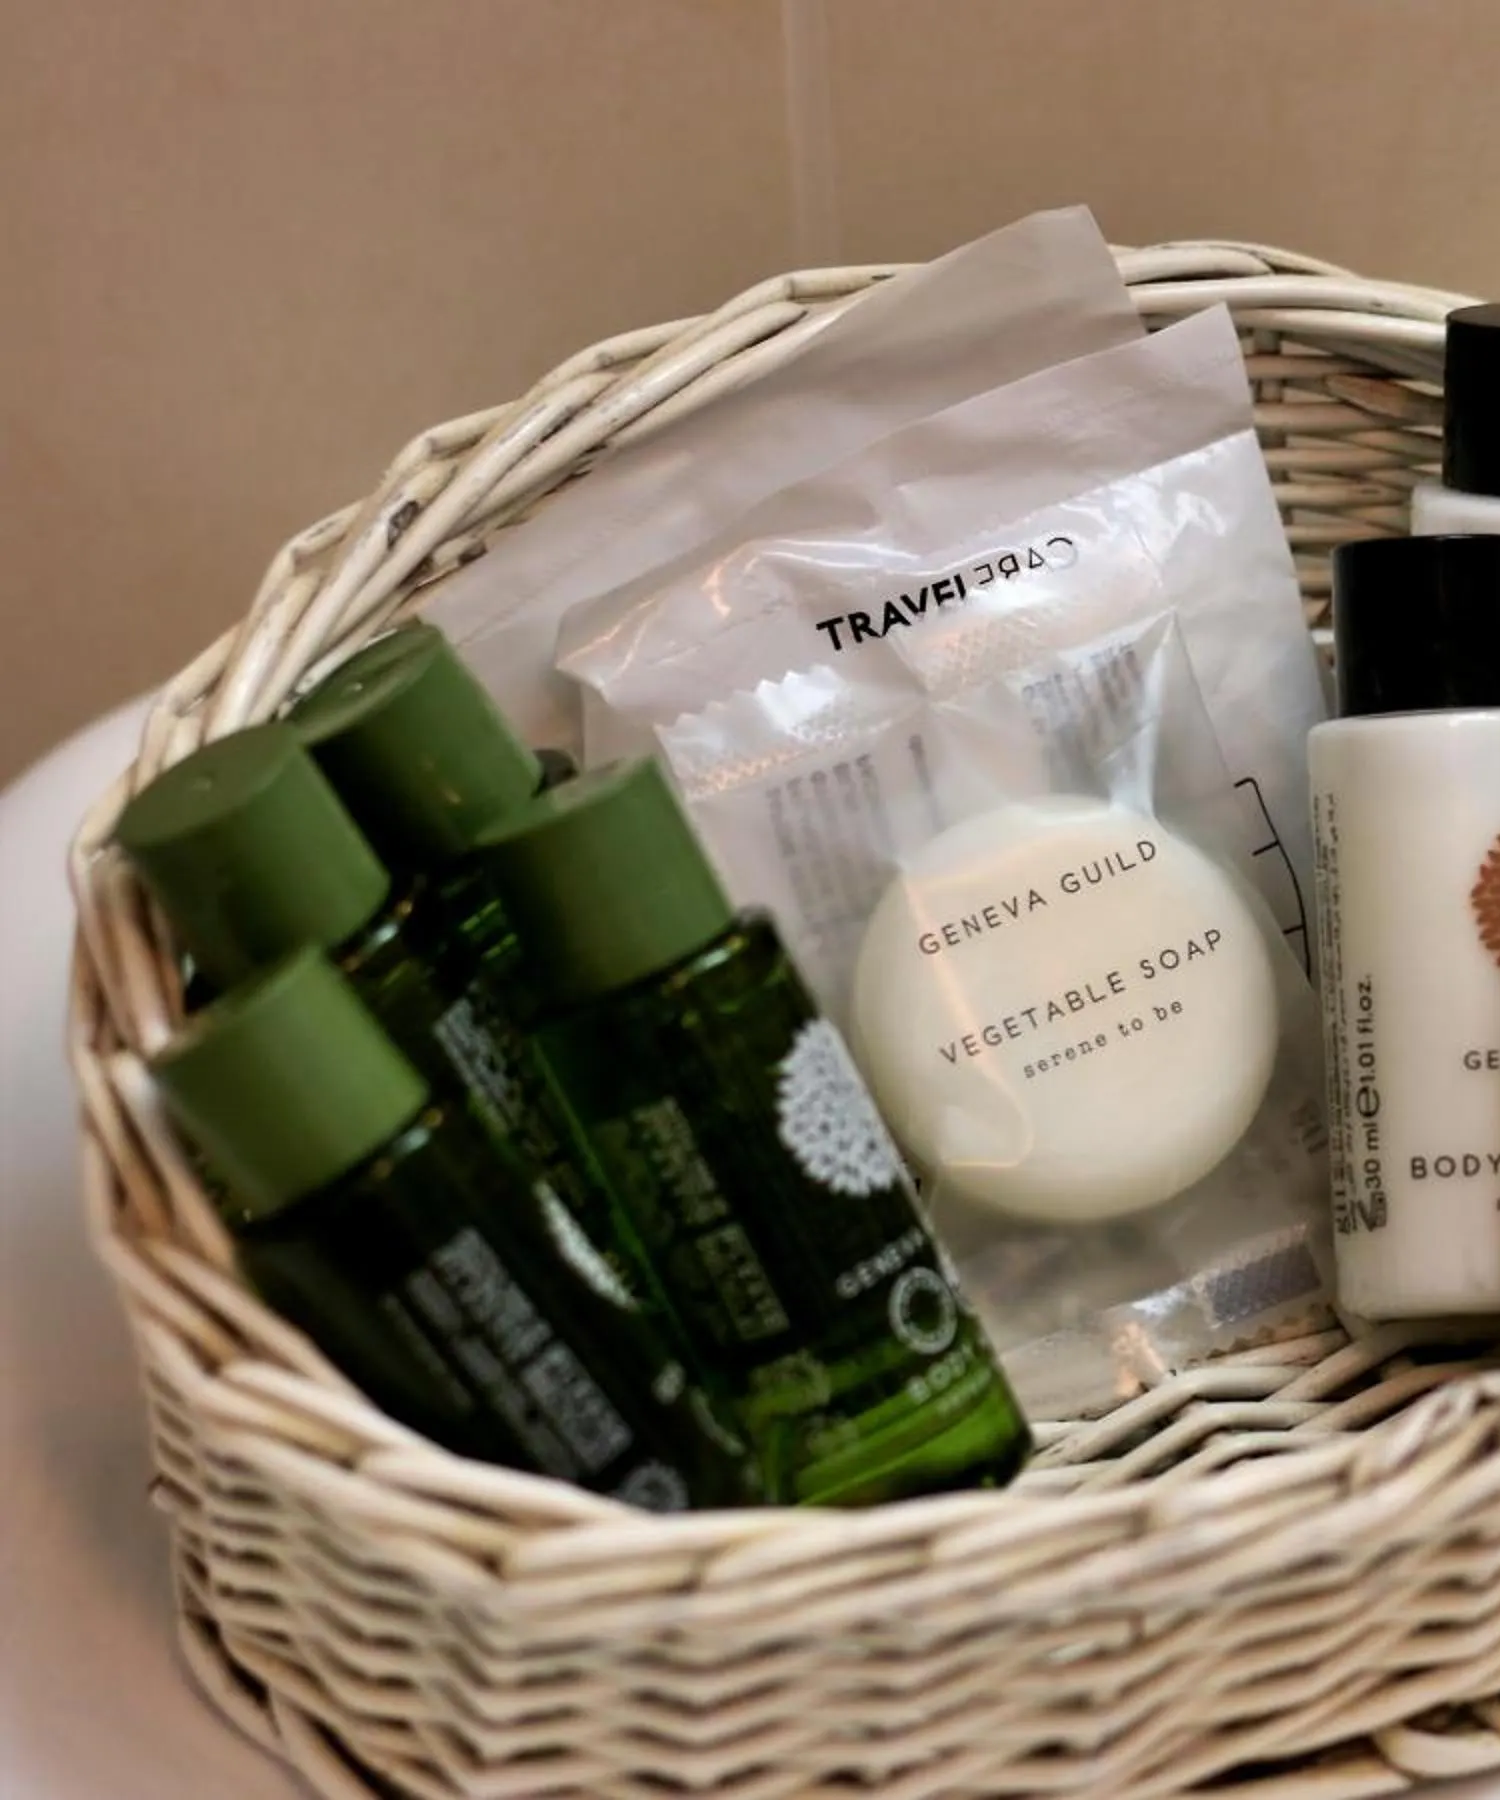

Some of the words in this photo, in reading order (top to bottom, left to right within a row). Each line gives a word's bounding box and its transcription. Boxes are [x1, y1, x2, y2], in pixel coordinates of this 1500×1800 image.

[917, 888, 1048, 956] GENEVA
[1060, 839, 1157, 894] GUILD
[939, 971, 1127, 1065] VEGETABLE
[1138, 928, 1222, 980] SOAP
[1023, 1033, 1108, 1079] serene
[1117, 1013, 1144, 1037] to
[1152, 999, 1184, 1022] be
[1356, 1042, 1376, 1085] 1.01
[1356, 1121, 1378, 1152] ml
[1362, 1157, 1382, 1190] 30
